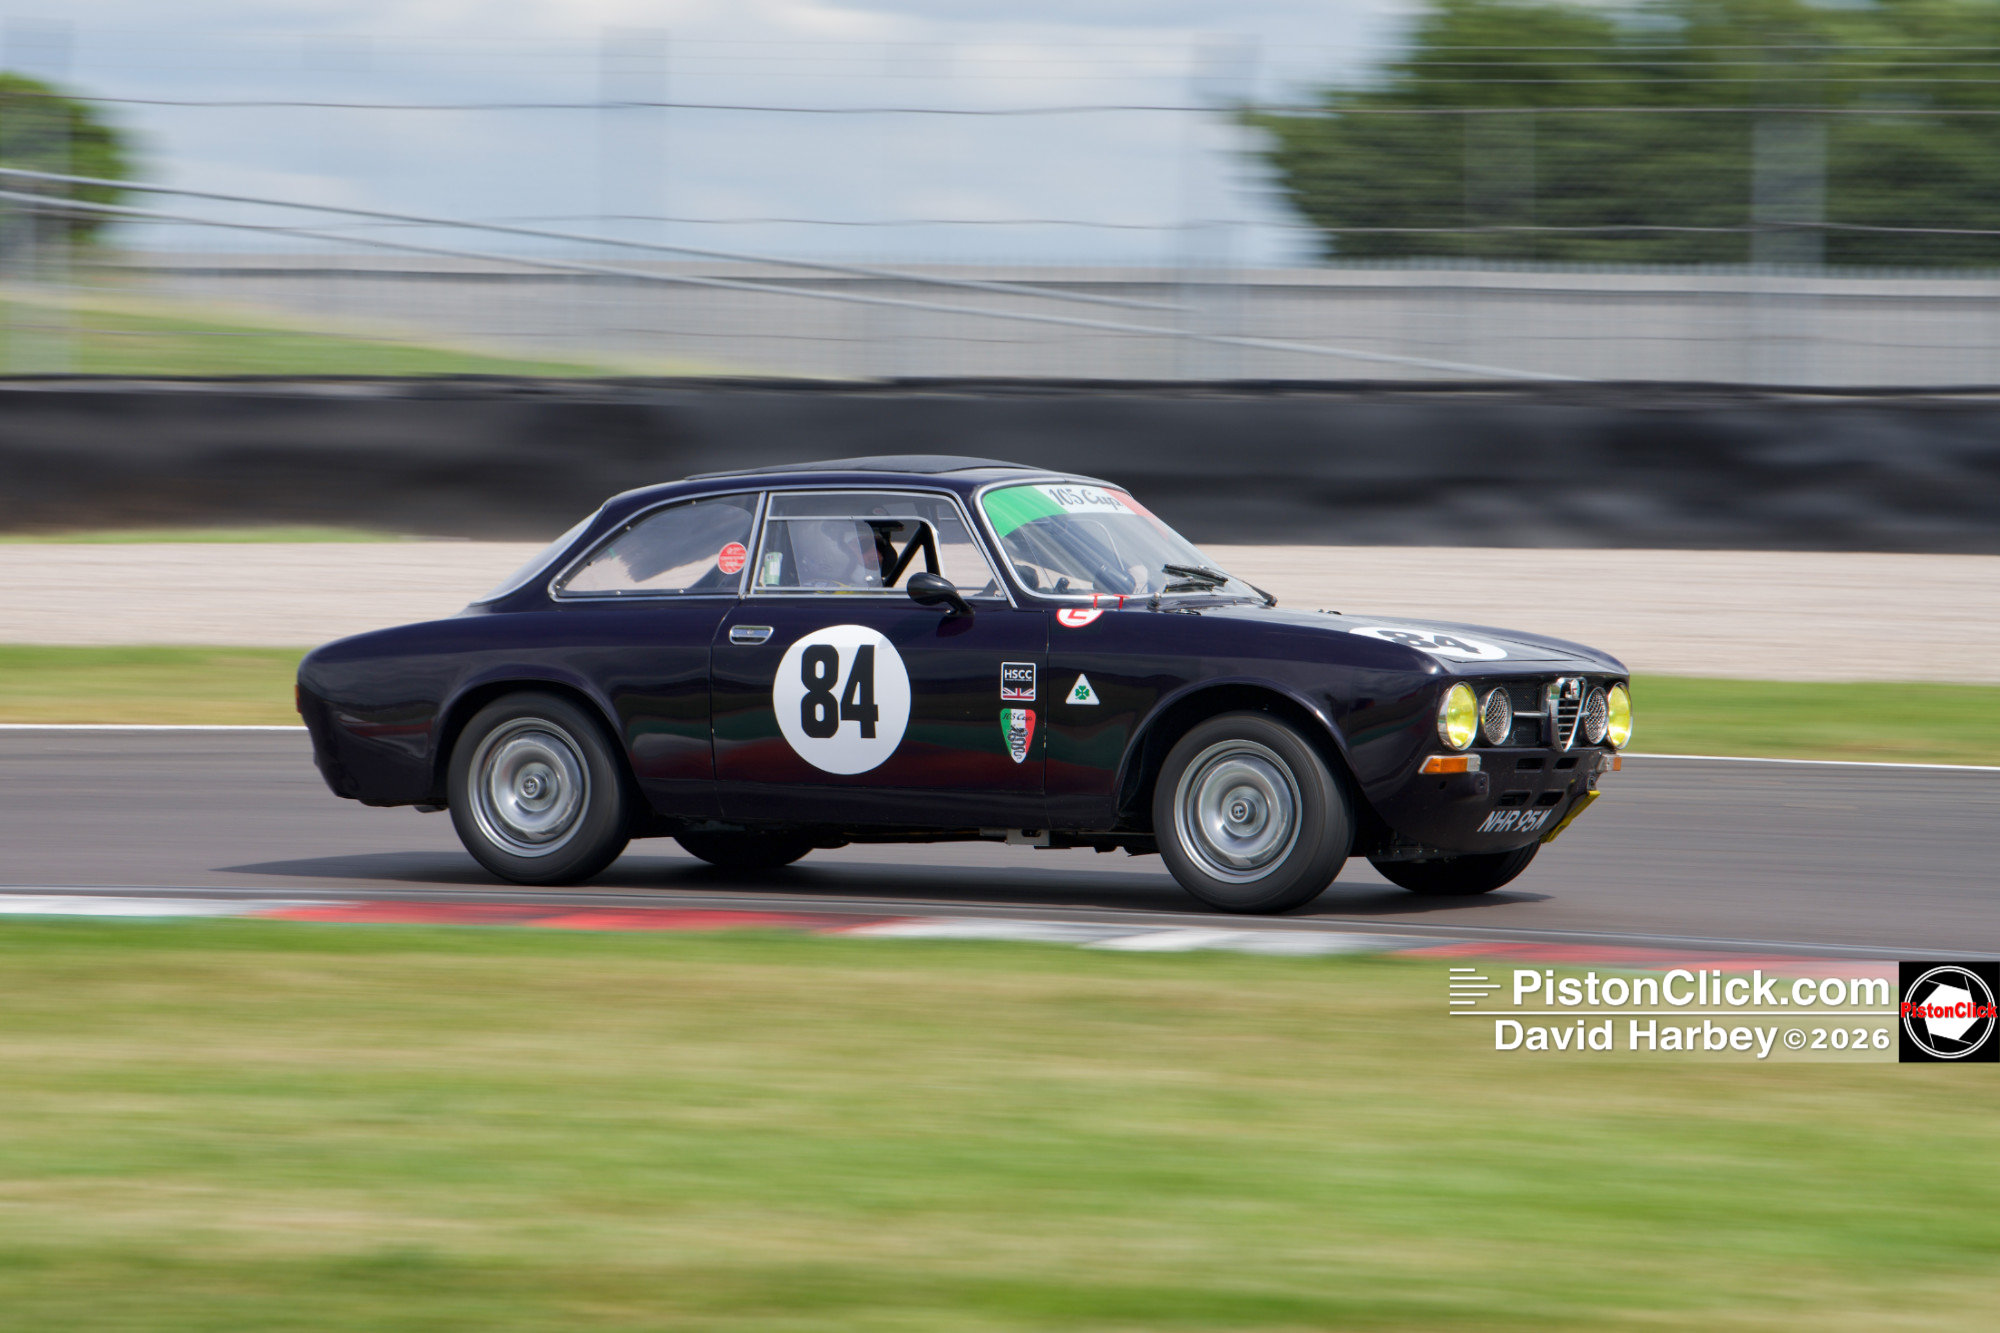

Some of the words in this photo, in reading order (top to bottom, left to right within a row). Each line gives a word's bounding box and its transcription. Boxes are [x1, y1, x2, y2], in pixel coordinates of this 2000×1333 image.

[1049, 488, 1084, 505] 105
[1082, 488, 1123, 510] Cup
[1377, 630, 1481, 654] 84
[1005, 669, 1032, 679] HSCC
[801, 644, 879, 739] 84
[1477, 810, 1520, 832] NHR
